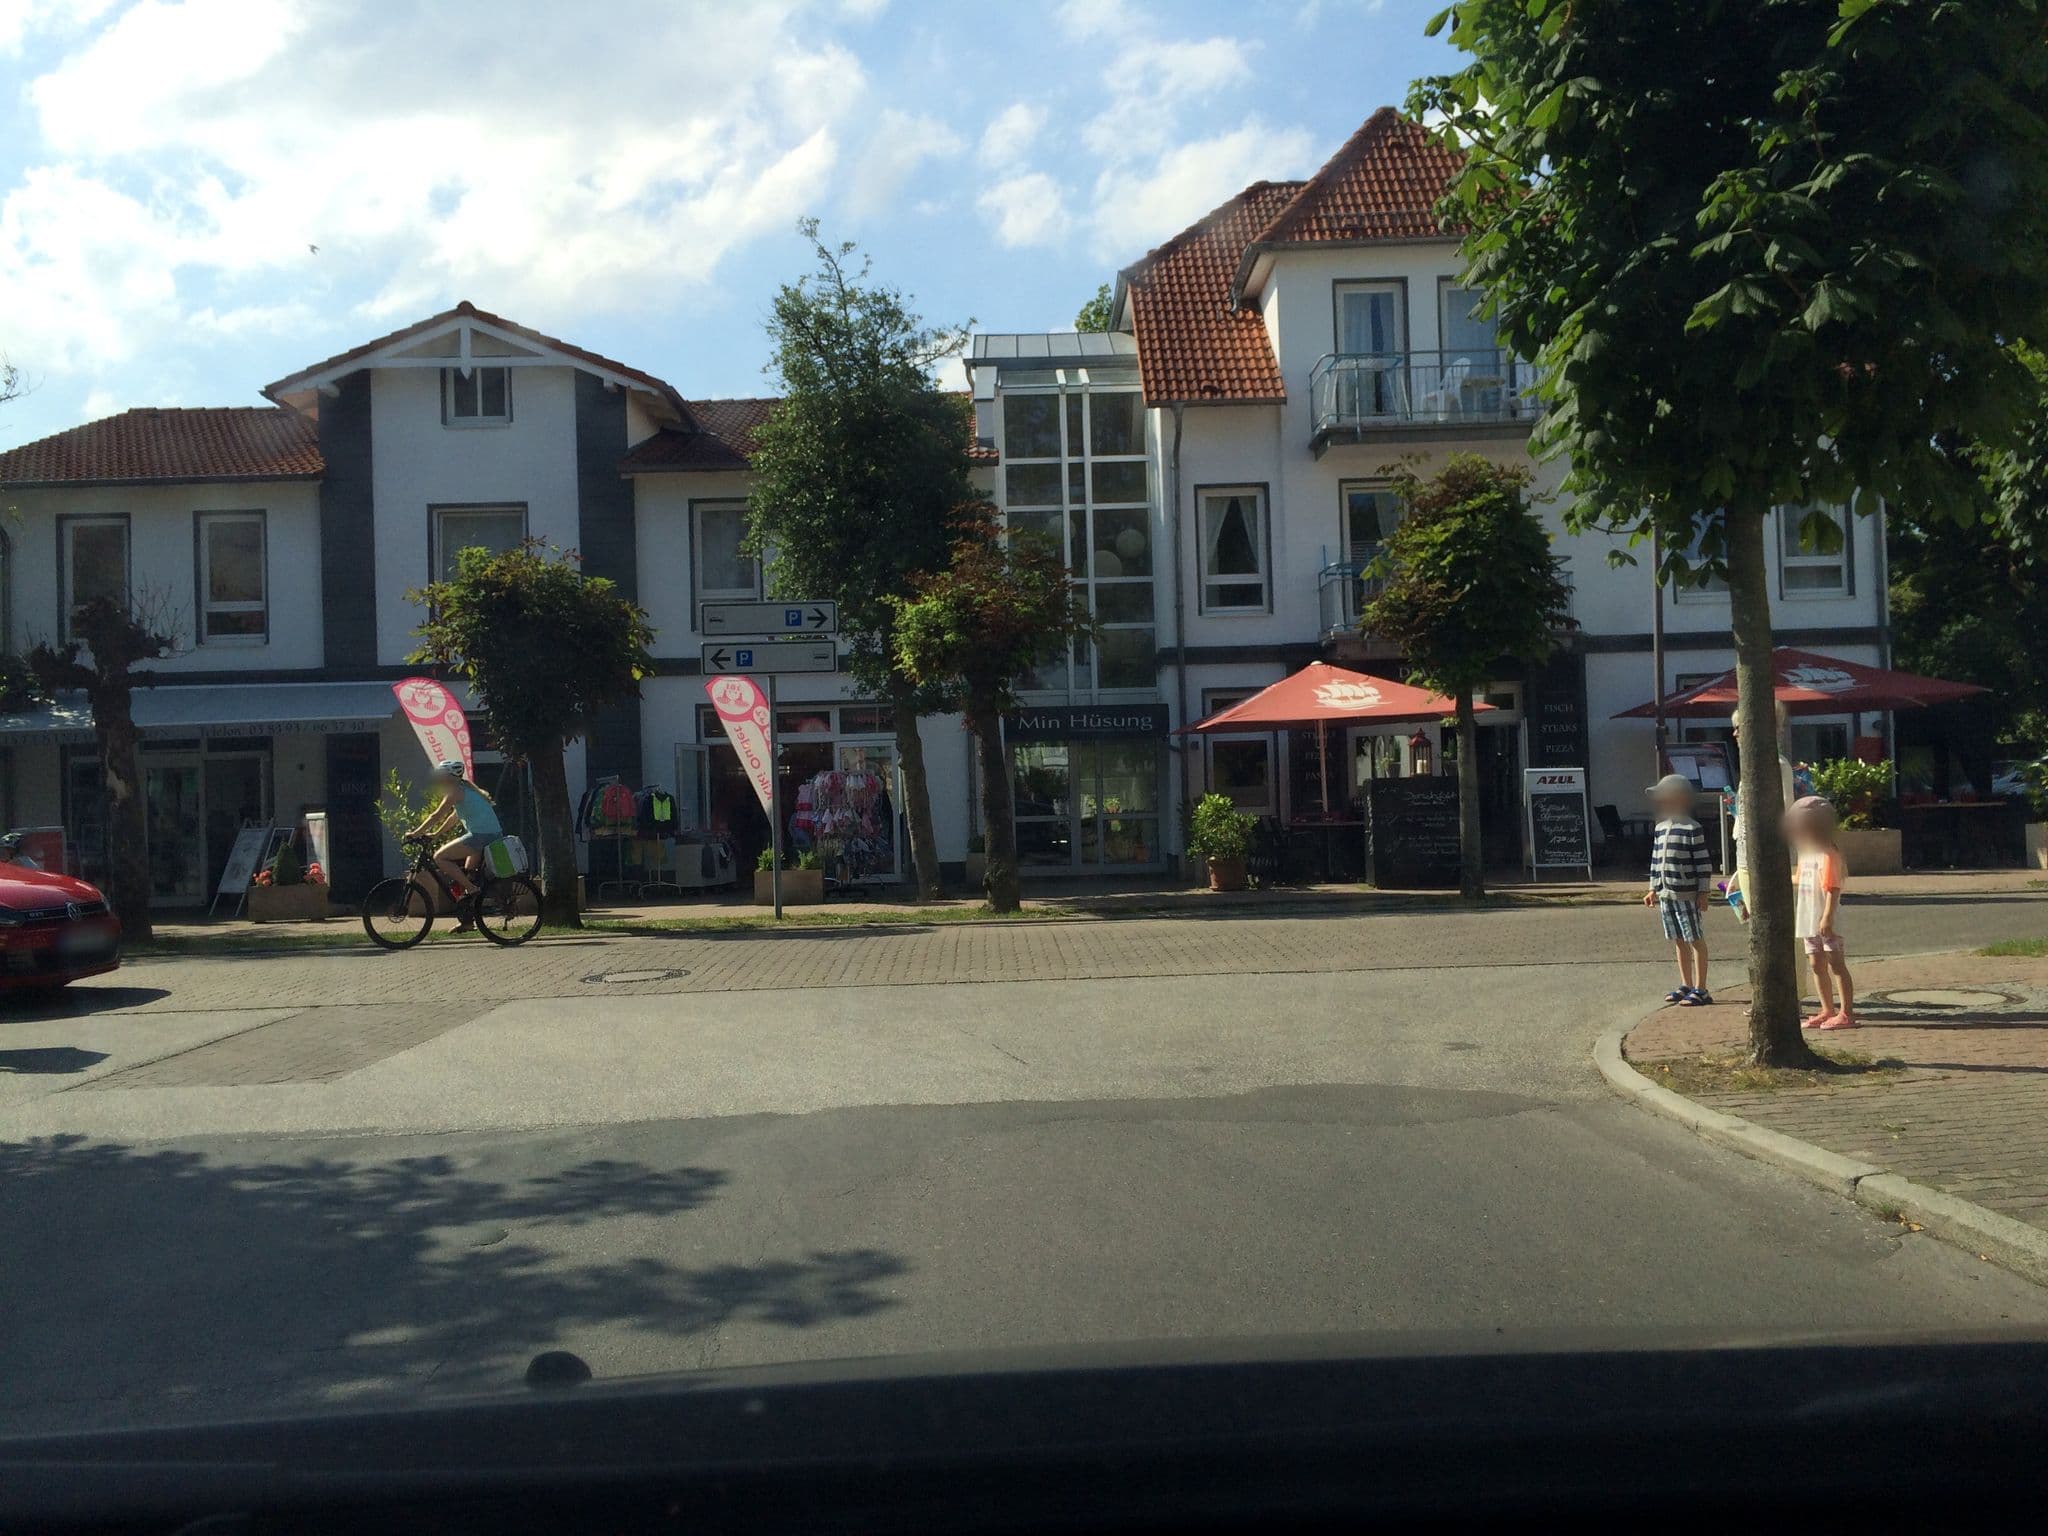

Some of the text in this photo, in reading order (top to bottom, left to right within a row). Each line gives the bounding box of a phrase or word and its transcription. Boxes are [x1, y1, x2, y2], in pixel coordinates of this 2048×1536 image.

[1018, 713, 1153, 731] Min Hüsung
[1545, 743, 1576, 753] PIZZA
[1537, 775, 1576, 785] AZUL
